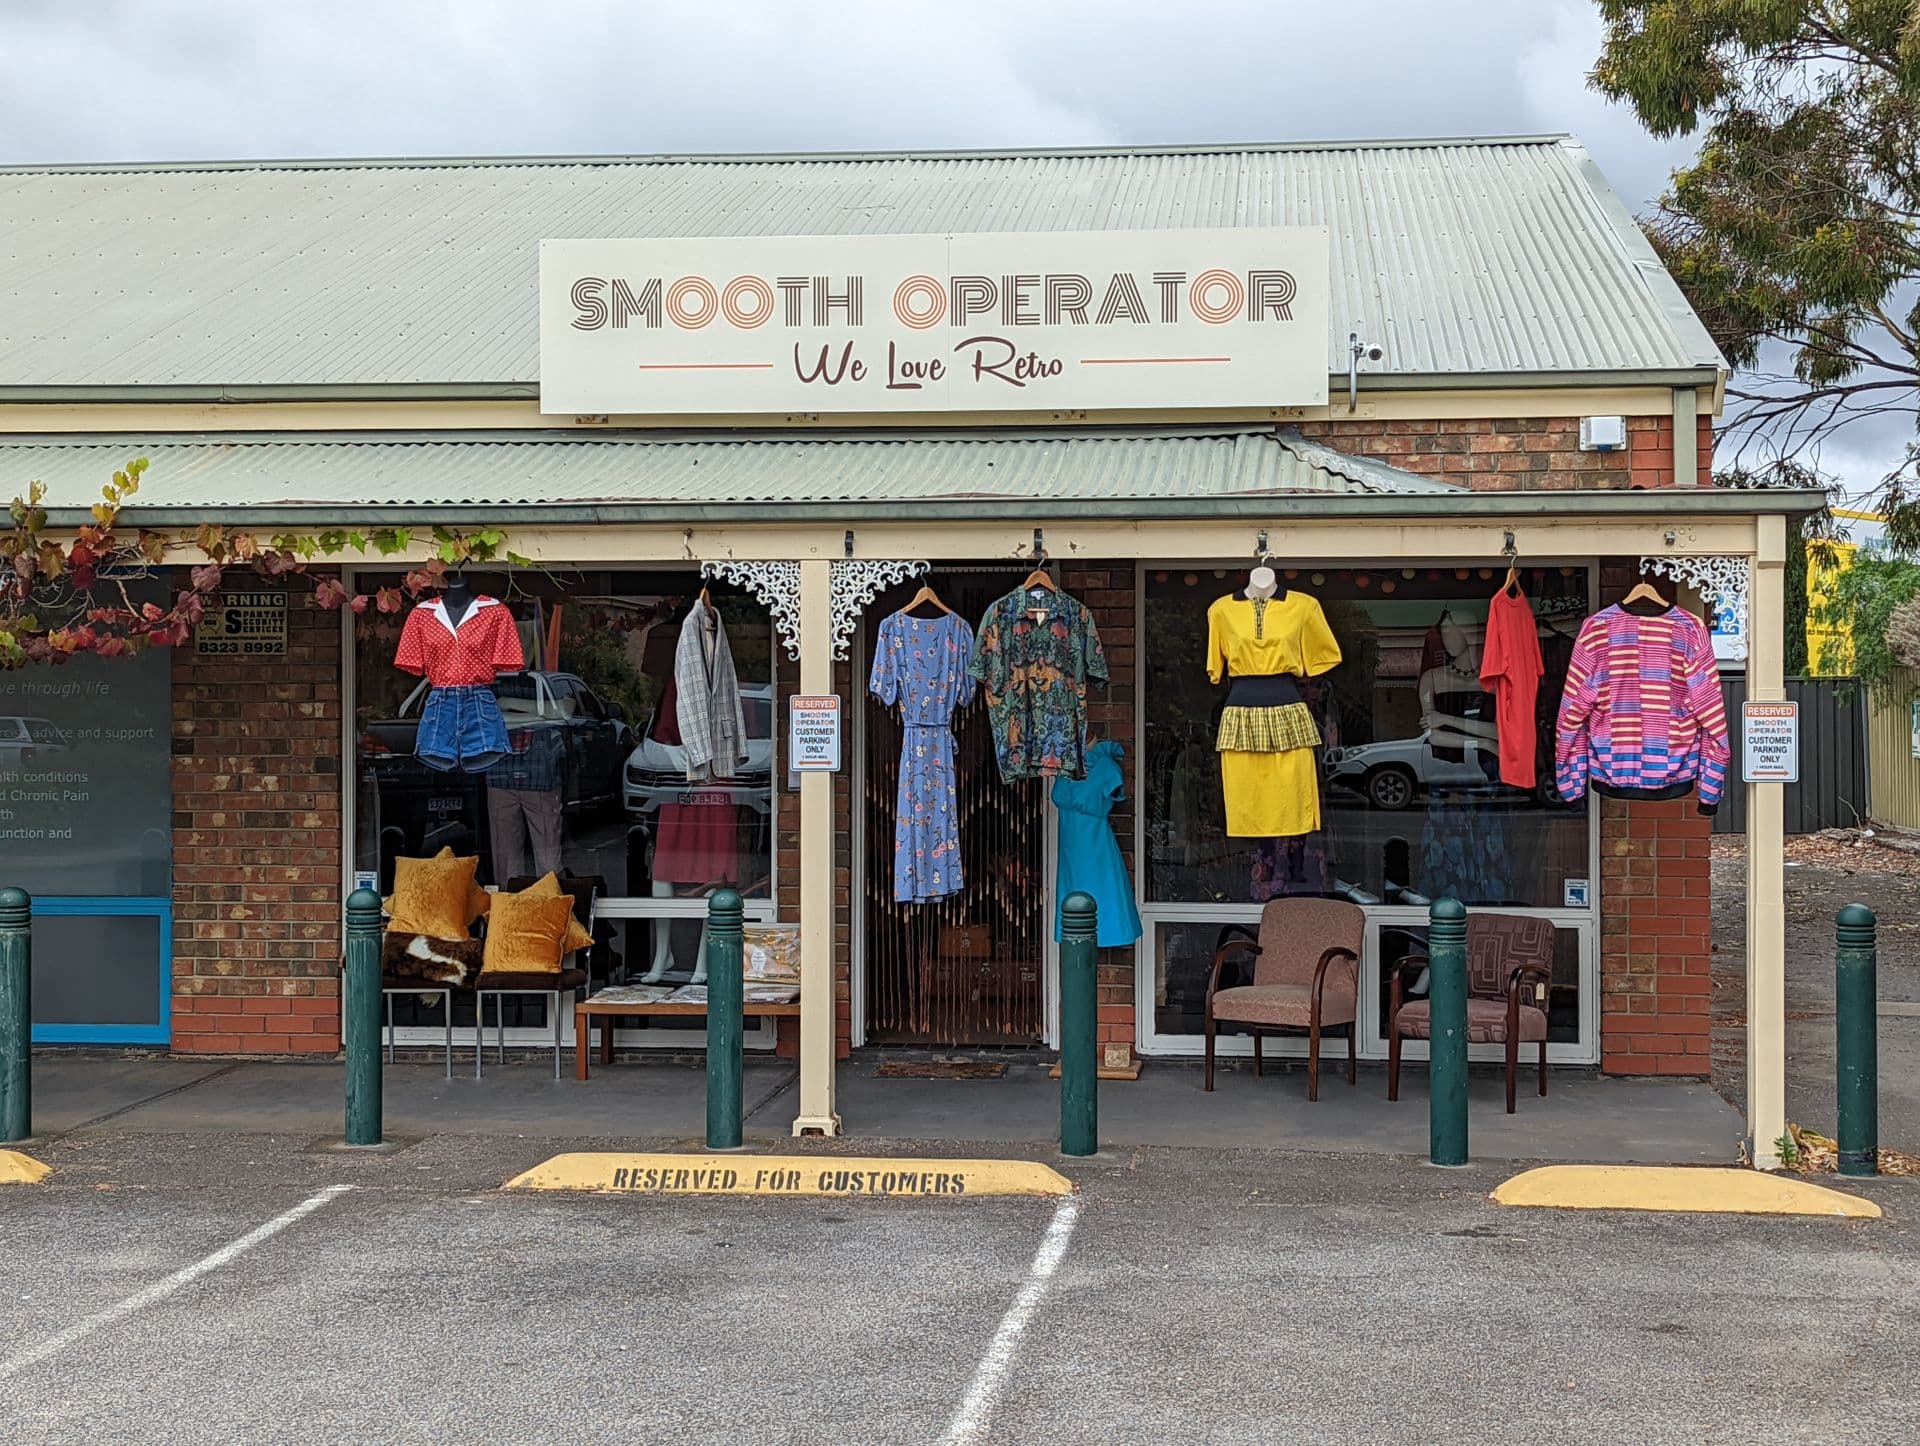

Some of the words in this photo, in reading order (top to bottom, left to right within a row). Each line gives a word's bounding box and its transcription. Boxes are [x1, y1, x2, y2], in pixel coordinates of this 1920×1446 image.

[570, 274, 863, 331] SMOOTH
[893, 268, 1298, 330] OPERATOR
[794, 340, 867, 383] We
[886, 341, 946, 390] Love
[954, 335, 1063, 388] Retro
[200, 594, 284, 606] WRNING
[199, 642, 238, 653] 8323
[244, 642, 284, 653] 8992
[21, 681, 80, 697] through
[86, 681, 110, 695] life
[795, 700, 835, 708] RESERVED
[1748, 706, 1793, 716] RESERVED
[32, 727, 73, 738] advice
[77, 727, 100, 738] and
[105, 727, 154, 740] support
[1760, 755, 1780, 763] ONLY
[0, 770, 19, 783] lth
[23, 771, 88, 783] conditions
[10, 790, 59, 800] Chronic
[63, 790, 89, 800] Pain
[48, 827, 72, 839] and
[613, 1168, 738, 1190] RESERVED
[755, 1170, 801, 1191] FOR
[818, 1171, 966, 1194] CUSTOMERS
